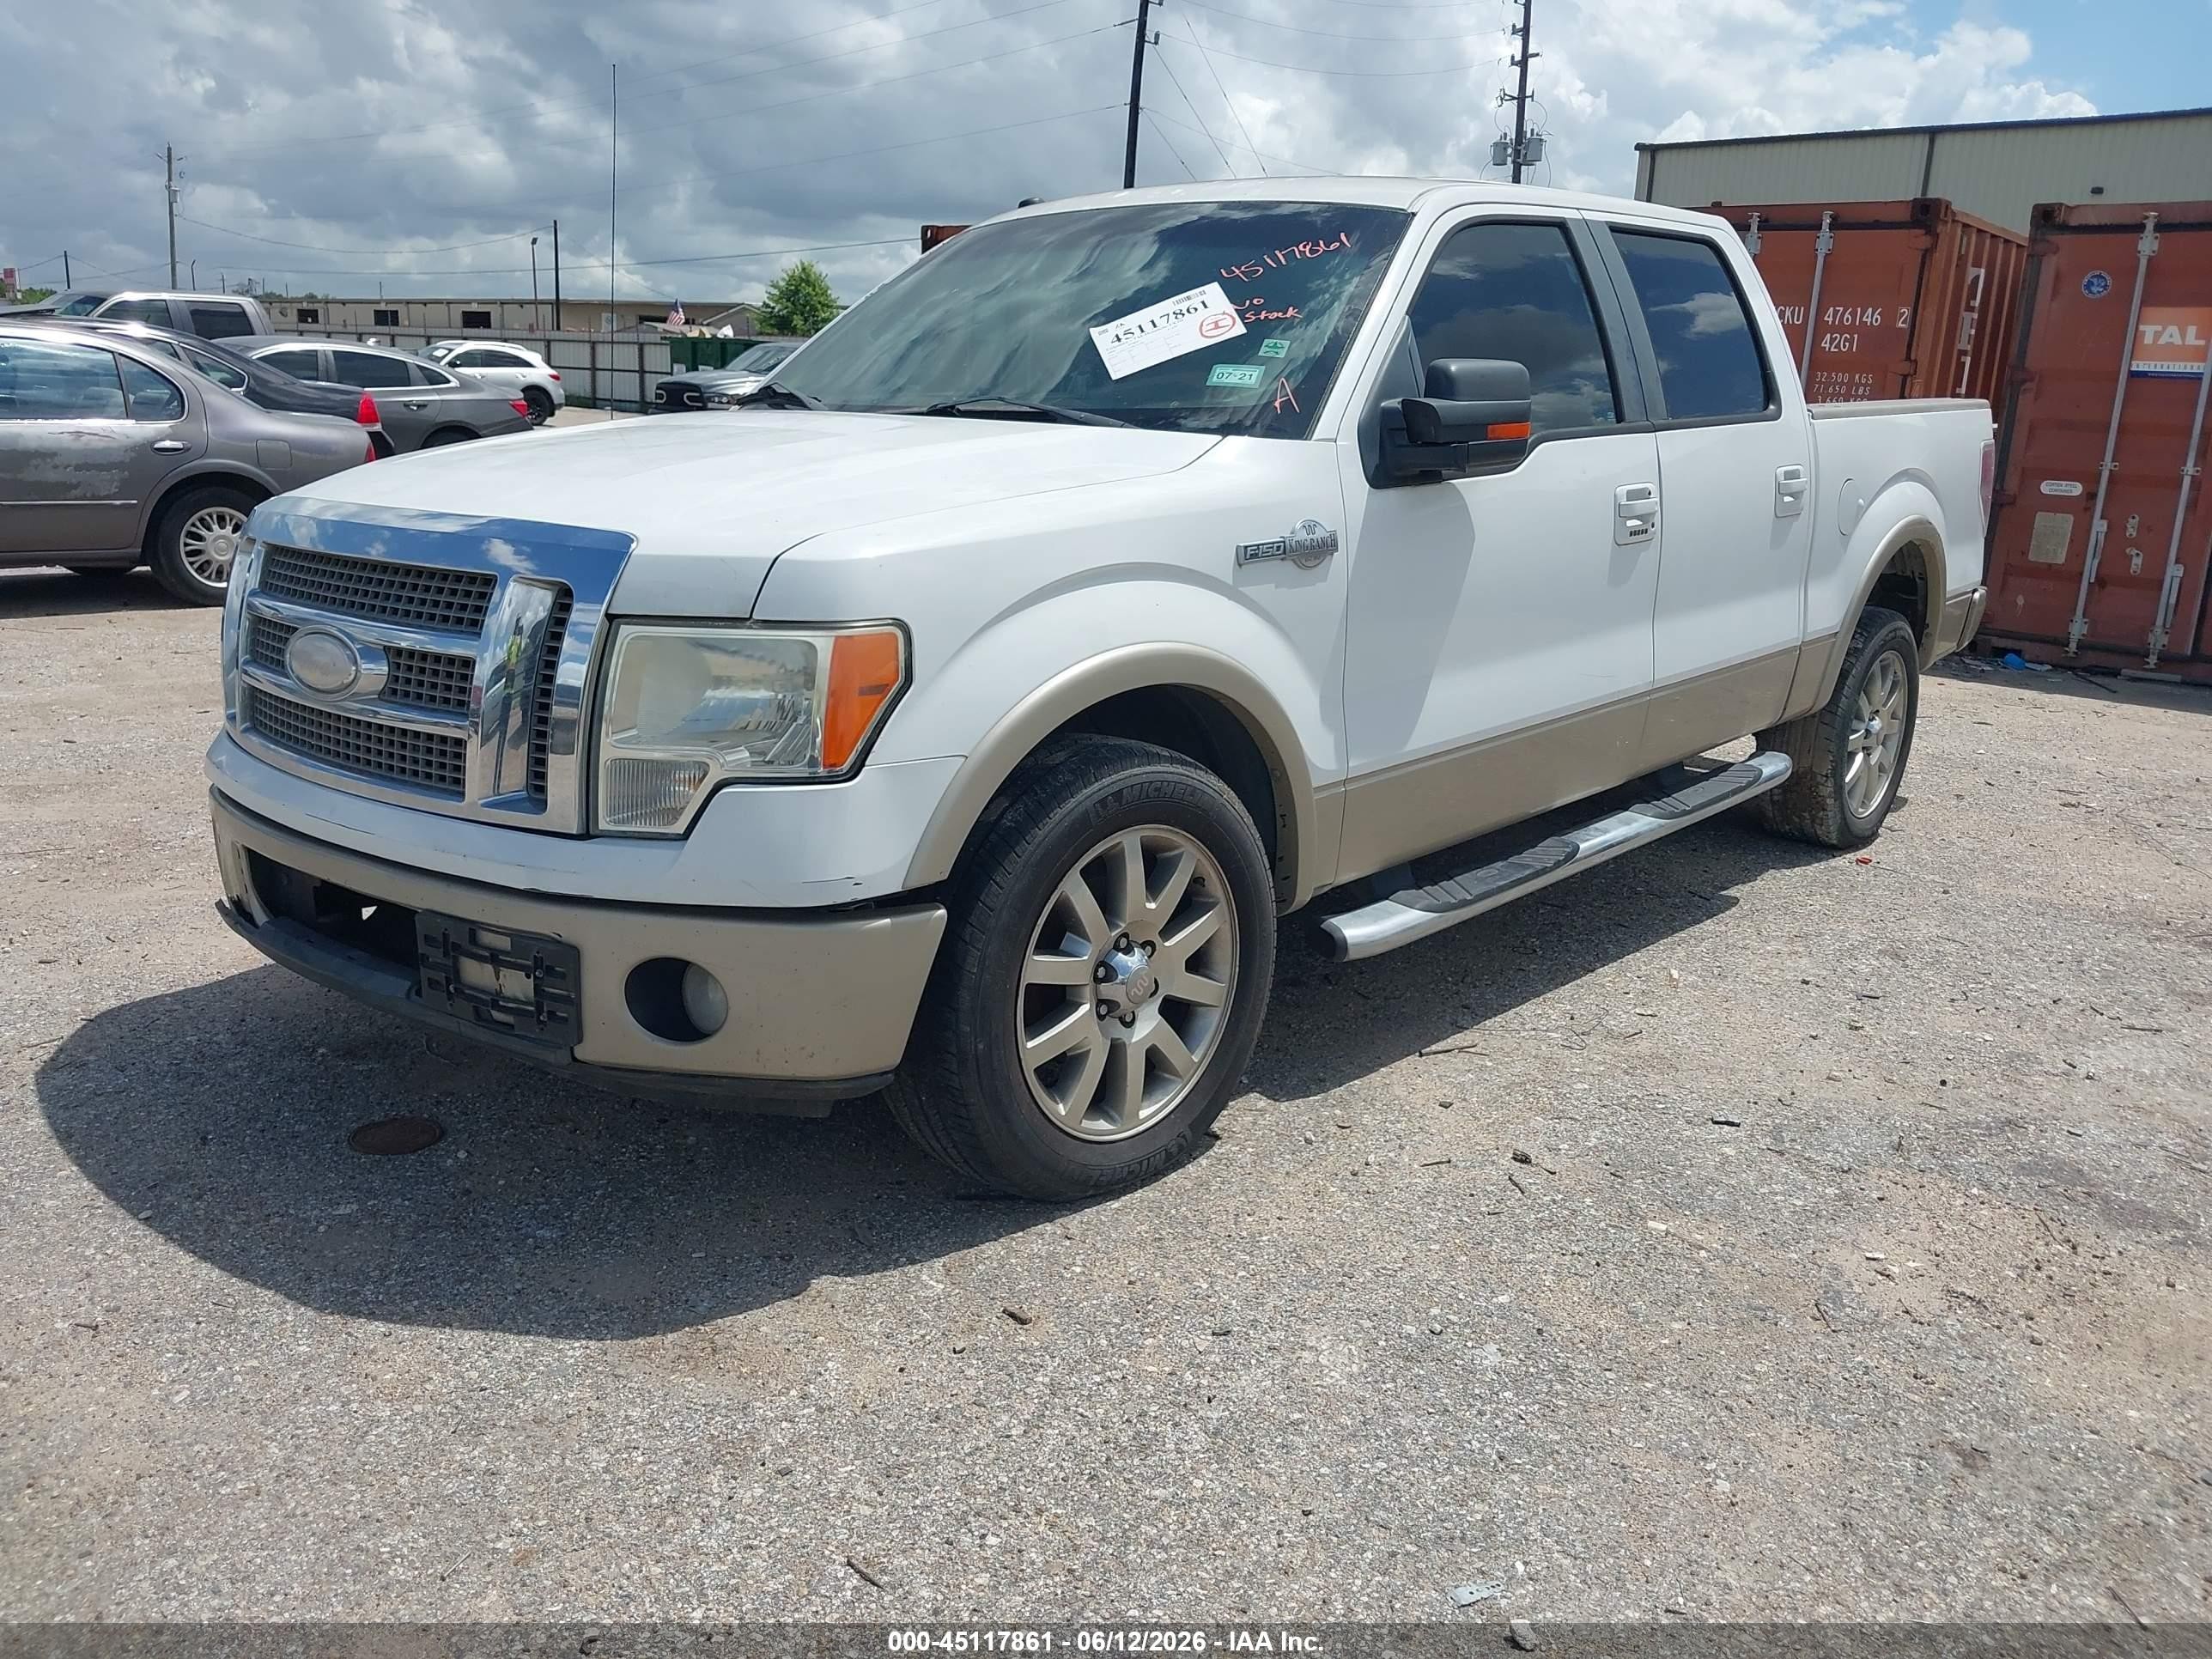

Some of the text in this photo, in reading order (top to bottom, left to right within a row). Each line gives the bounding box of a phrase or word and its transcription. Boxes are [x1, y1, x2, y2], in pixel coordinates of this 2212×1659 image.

[1220, 232, 1352, 282] 45117861
[1110, 300, 1210, 344] 45117861
[1776, 306, 1909, 327] CKU 476146 2
[1820, 333, 1859, 352] 42G1
[2138, 325, 2206, 346] TAL
[1815, 371, 1874, 385] 32.500 KGS
[1273, 377, 1300, 414] A
[1851, 386, 1871, 396] LBS
[1245, 542, 1285, 559] F-150
[1287, 532, 1336, 554] KING RANCH
